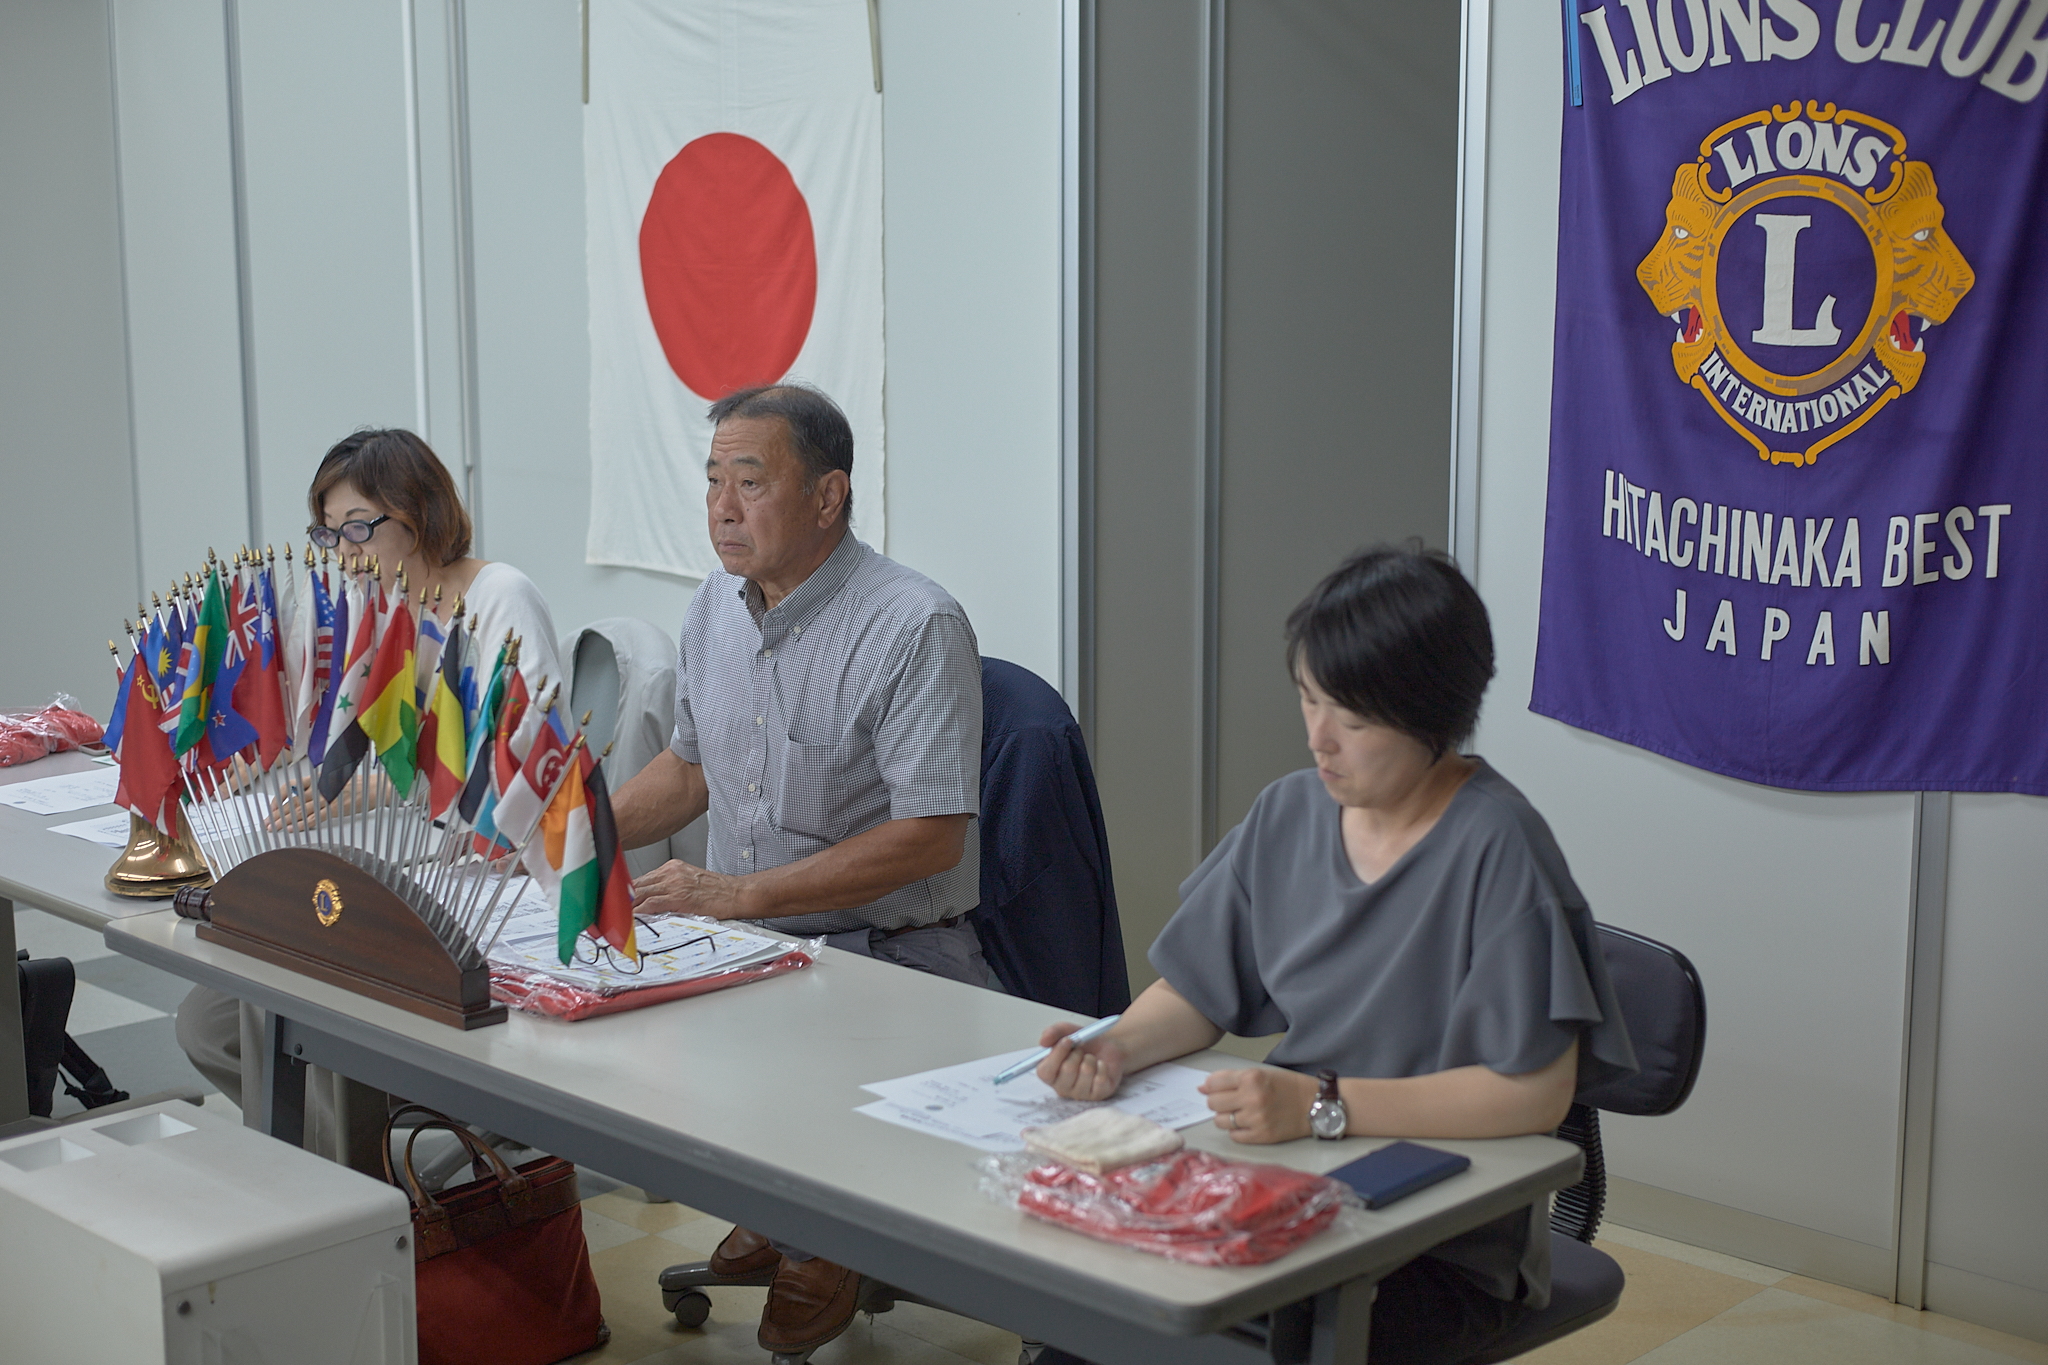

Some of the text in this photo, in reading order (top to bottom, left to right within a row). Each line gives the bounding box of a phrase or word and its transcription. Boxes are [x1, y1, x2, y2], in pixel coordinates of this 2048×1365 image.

[1580, 0, 2048, 105] LIONS CLUB
[1714, 120, 1891, 188] LIONS
[1752, 213, 1842, 346] L
[1700, 351, 1891, 433] INTERNATIONAL
[1881, 504, 2012, 588] BEST
[320, 894, 329, 912] L
